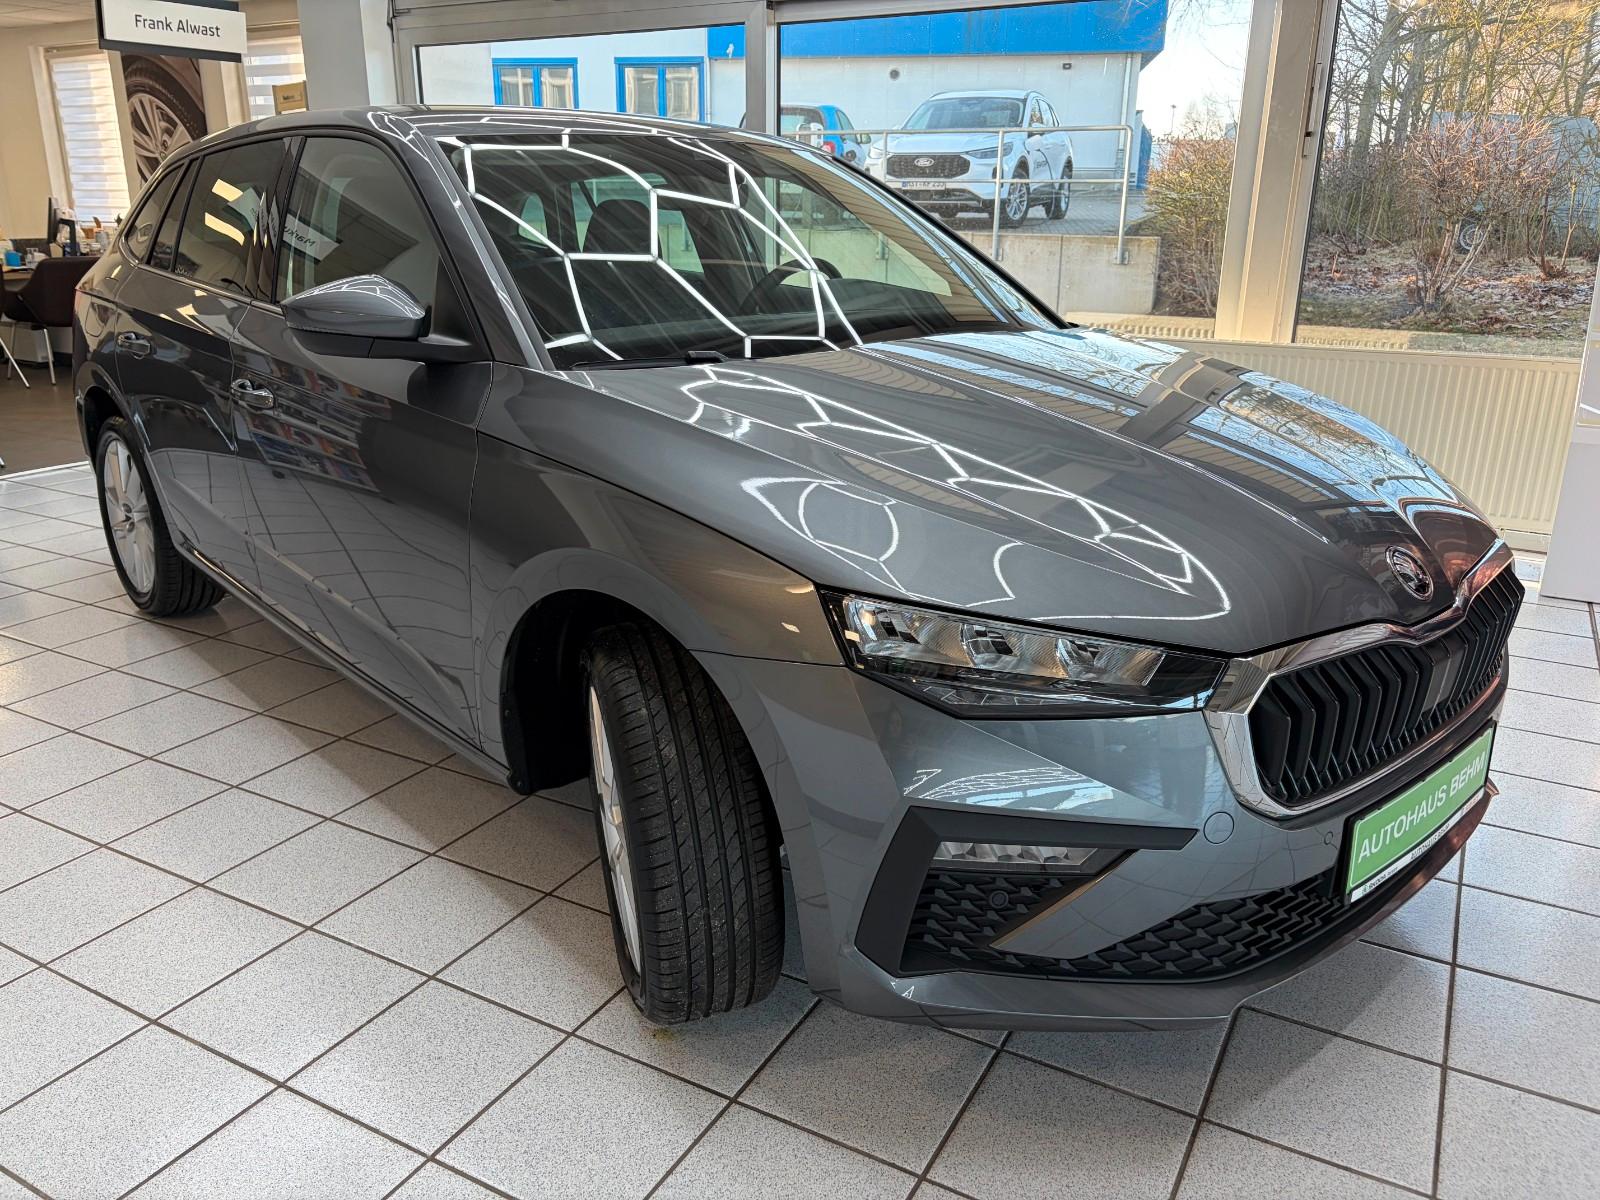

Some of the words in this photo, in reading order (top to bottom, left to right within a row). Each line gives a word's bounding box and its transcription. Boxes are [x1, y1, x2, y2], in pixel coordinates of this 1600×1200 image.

[134, 14, 173, 32] Frank
[176, 19, 221, 37] Alwast
[1358, 784, 1448, 863] AUTOHAUS
[1450, 751, 1486, 797] BEHM
